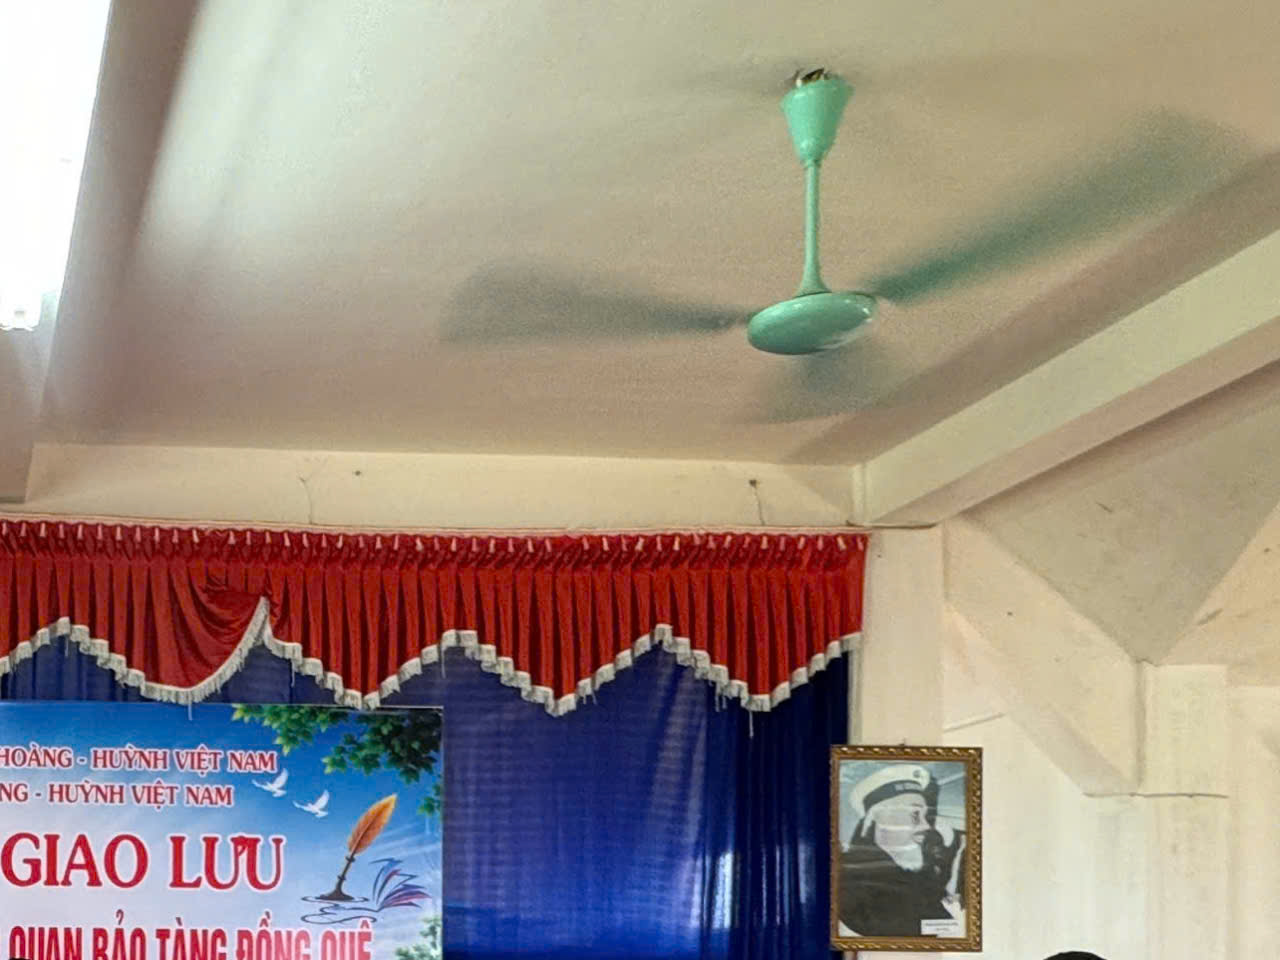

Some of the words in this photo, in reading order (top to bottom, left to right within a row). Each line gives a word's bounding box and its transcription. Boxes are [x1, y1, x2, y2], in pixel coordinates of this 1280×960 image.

[93, 744, 167, 769] HUỲNH
[176, 745, 222, 775] VIỆT
[229, 752, 276, 772] NAM
[49, 780, 124, 804] HUỲNH
[132, 780, 179, 809] VIỆT
[186, 786, 232, 805] NAM
[0, 832, 149, 889] GIAO
[169, 834, 284, 890] LƯU
